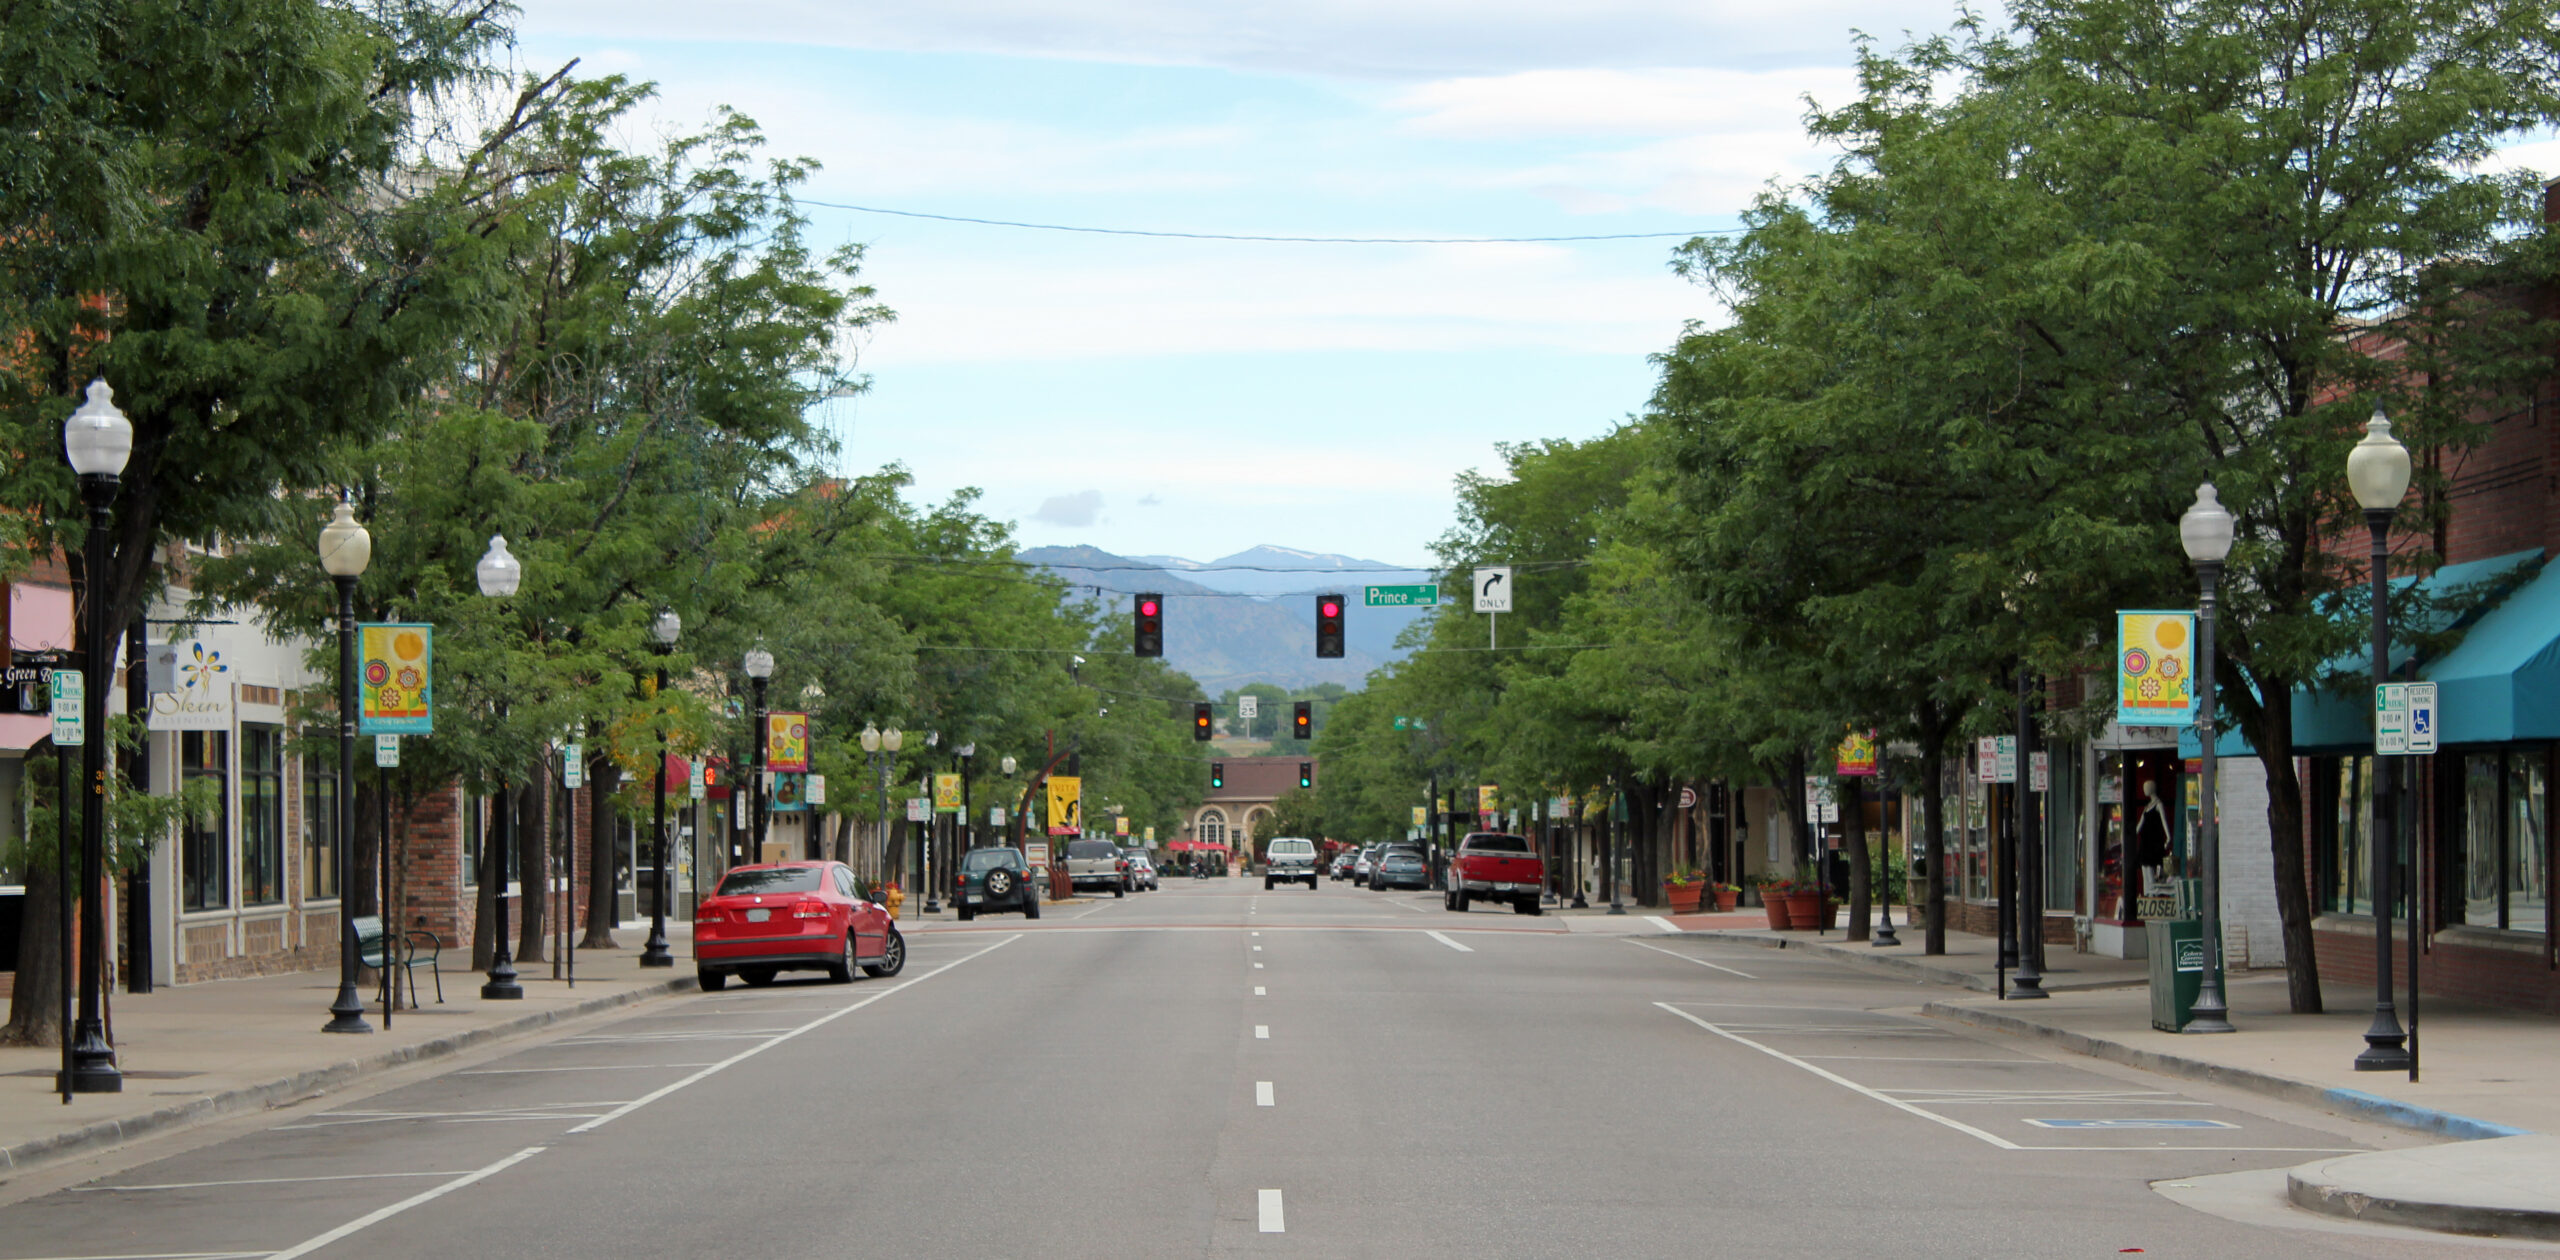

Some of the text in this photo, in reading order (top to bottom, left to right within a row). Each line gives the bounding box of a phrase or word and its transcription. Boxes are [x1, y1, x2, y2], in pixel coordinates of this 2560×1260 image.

[1370, 587, 1408, 604] Prince
[1479, 600, 1506, 608] ONLY
[6, 665, 37, 689] Green
[54, 676, 61, 695] 2
[2392, 688, 2399, 697] HR
[155, 685, 227, 716] Skin
[2379, 690, 2384, 708] 2
[71, 702, 78, 712] AM
[2387, 700, 2405, 708] PARKING
[1241, 707, 1255, 716] 25
[155, 716, 224, 725] ESSENTIALS
[2382, 713, 2401, 723] 9:00 AM
[75, 727, 82, 737] PM
[2398, 736, 2404, 745] PM
[1984, 741, 1992, 750] NO
[1979, 752, 1996, 760] PARKING
